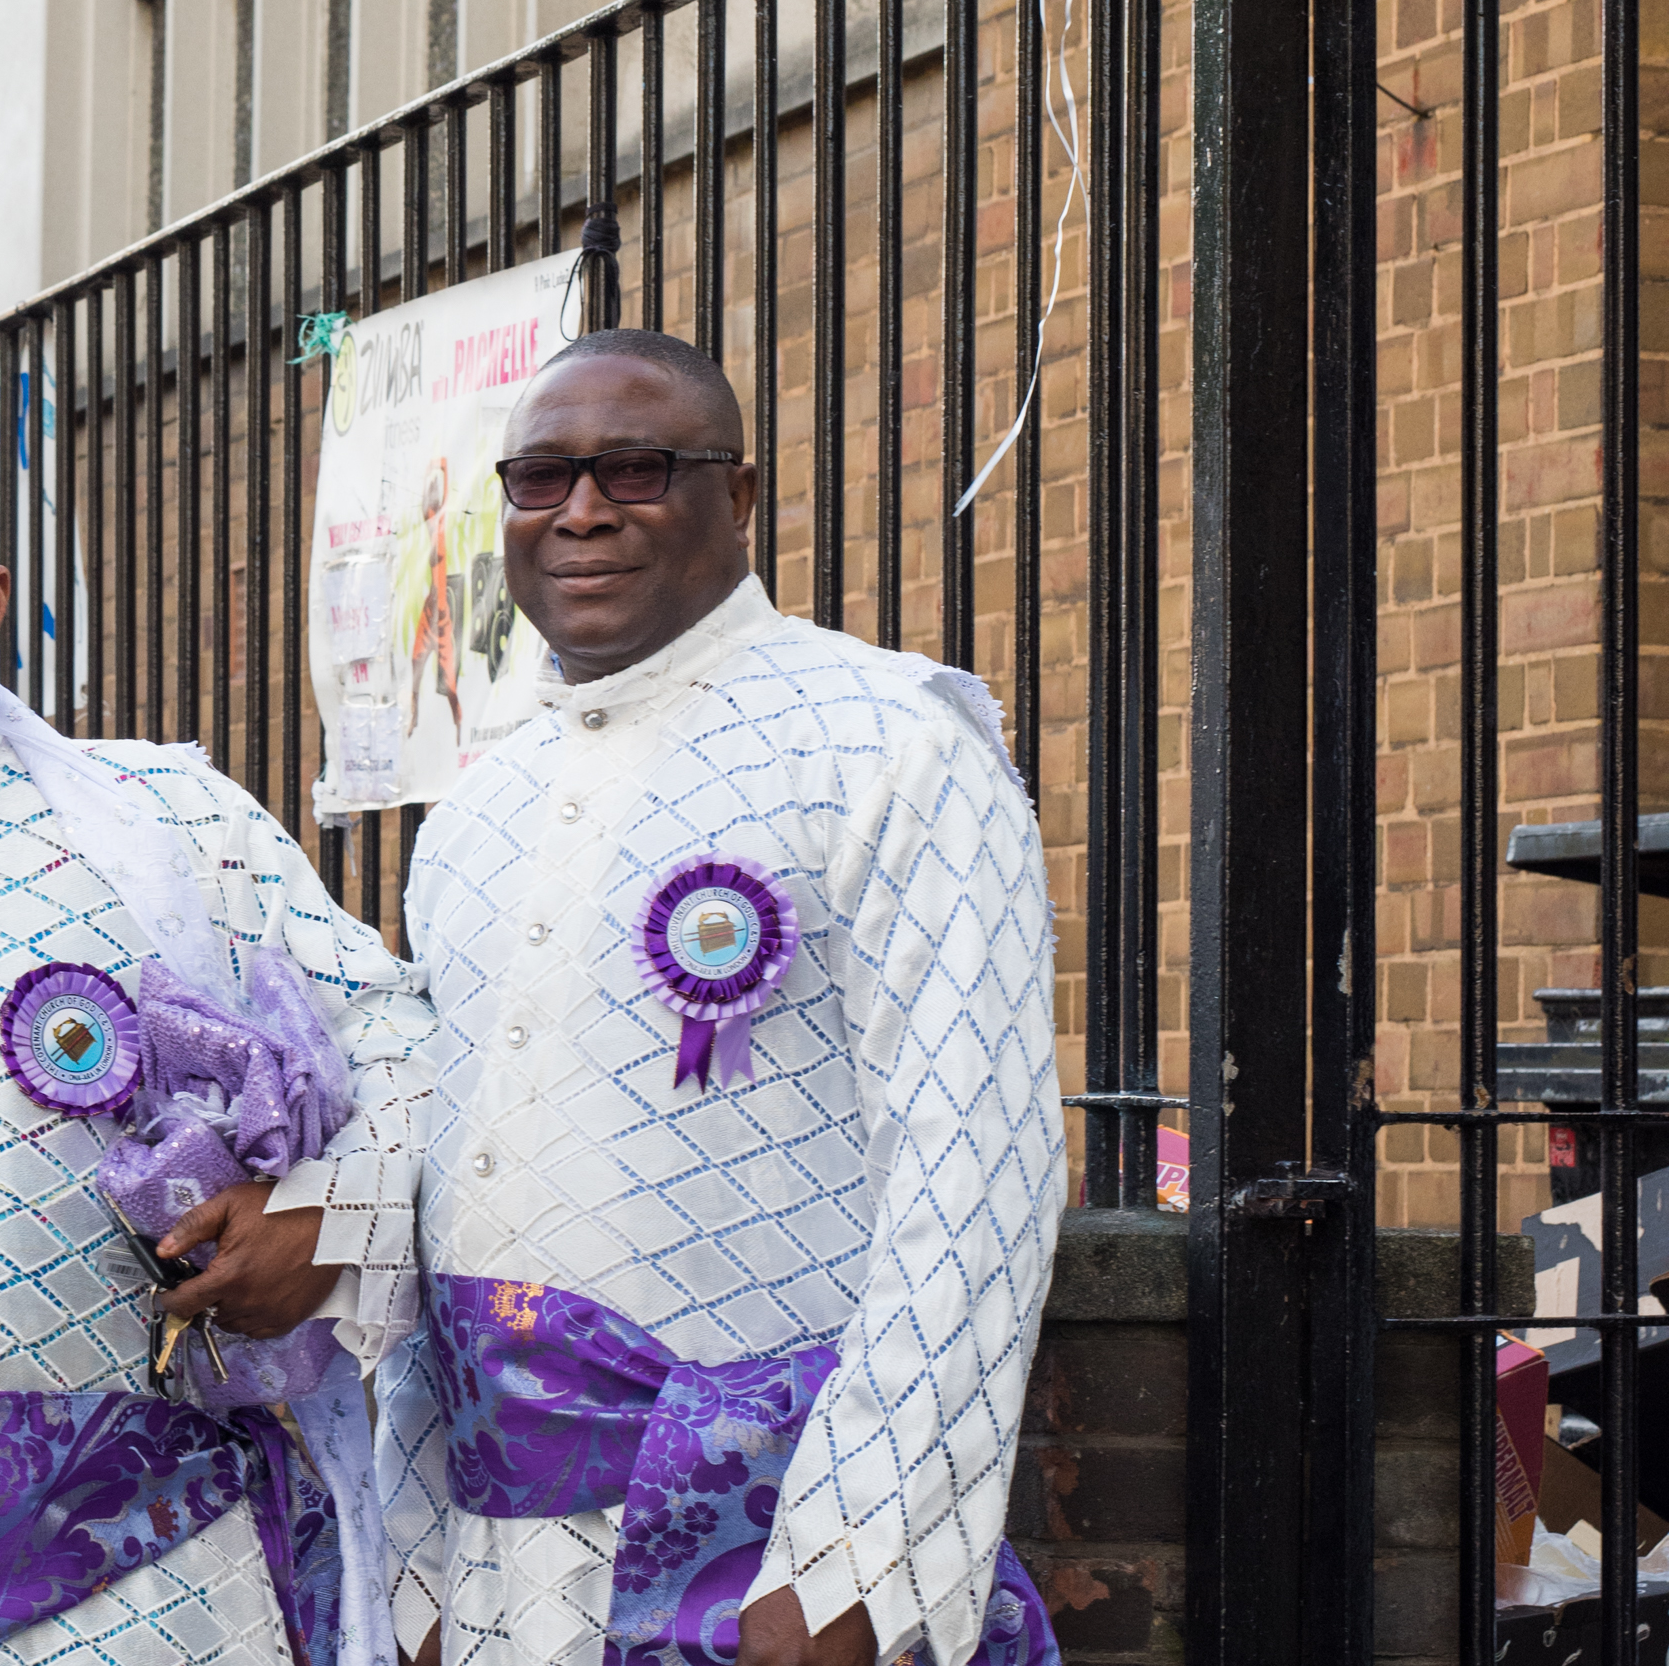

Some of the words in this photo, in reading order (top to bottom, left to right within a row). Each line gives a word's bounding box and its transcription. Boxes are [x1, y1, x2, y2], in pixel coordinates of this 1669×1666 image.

[453, 317, 539, 397] PACHELLE
[360, 321, 422, 416] ZUMBA
[695, 888, 730, 901] CHURCH
[731, 893, 743, 903] OF
[670, 897, 695, 937] COVENANT
[740, 901, 755, 919] GOD
[670, 940, 681, 954] THE
[39, 997, 66, 1020] CHURCH
[67, 996, 77, 1005] OF
[79, 998, 97, 1013] GOD
[32, 1021, 47, 1062] COVENANT
[45, 1062, 60, 1077] THE
